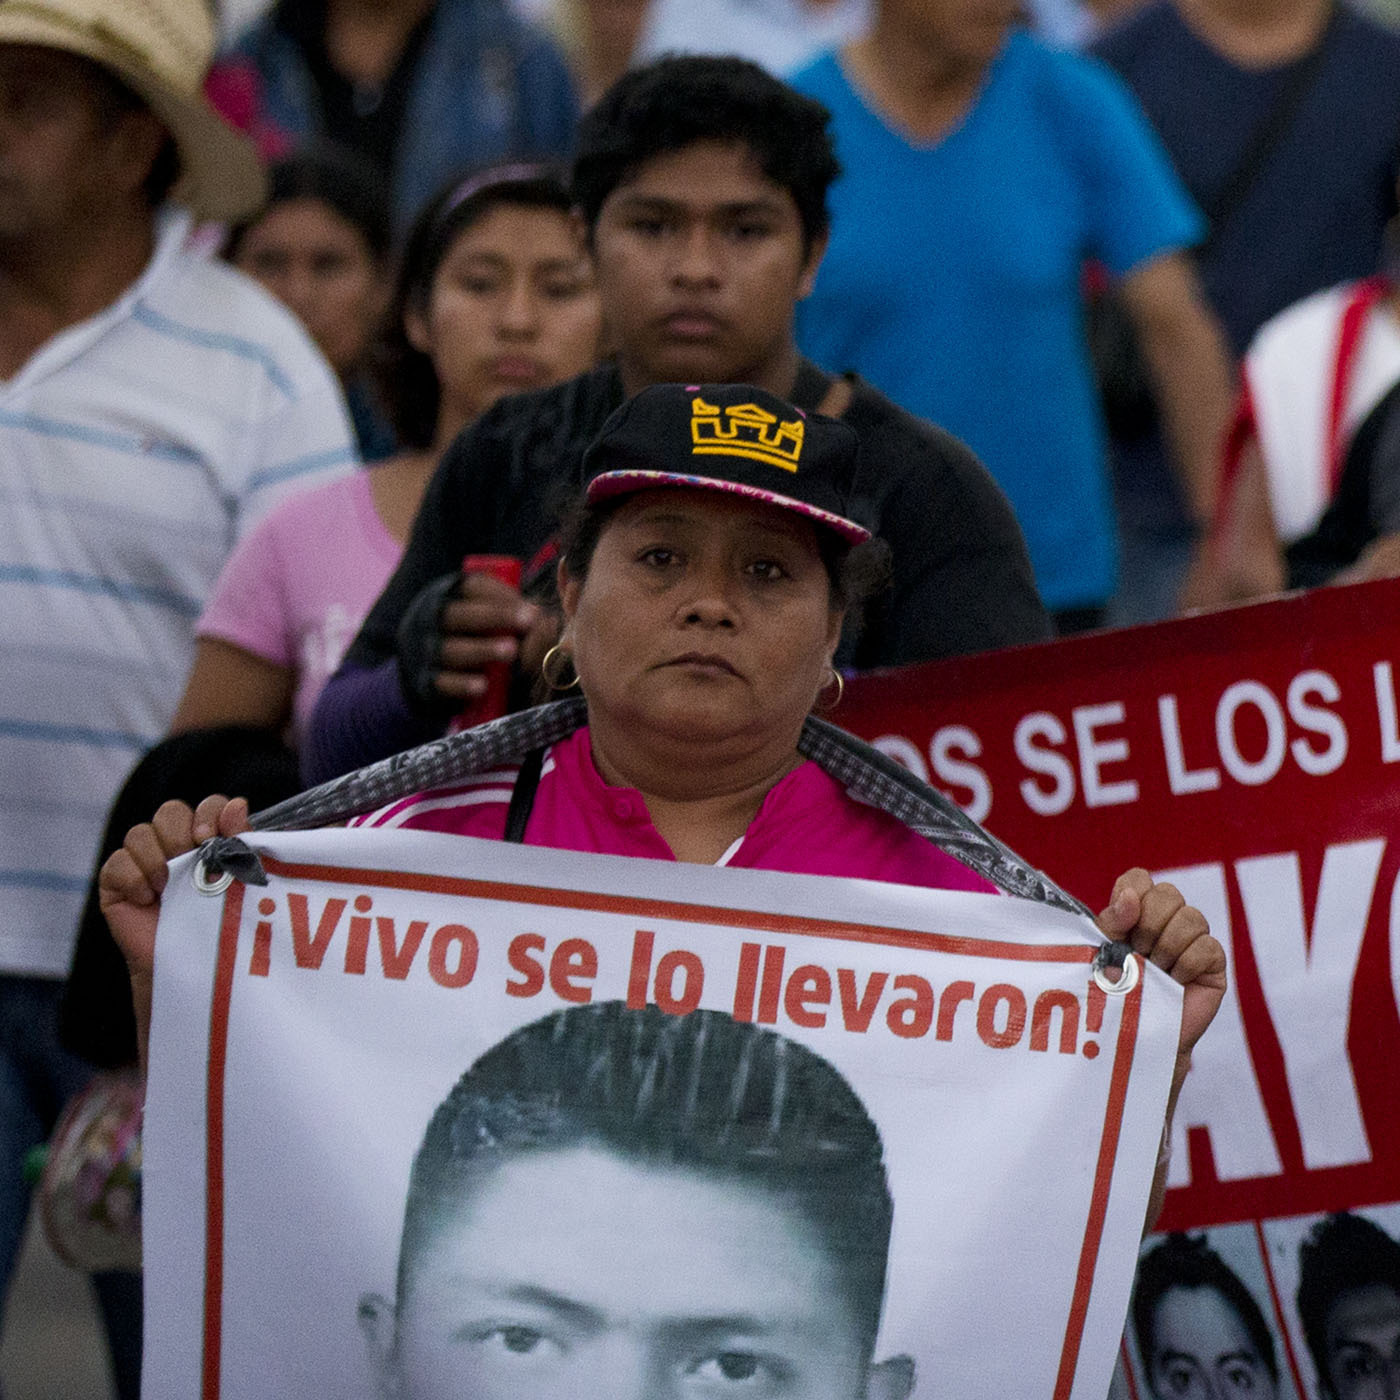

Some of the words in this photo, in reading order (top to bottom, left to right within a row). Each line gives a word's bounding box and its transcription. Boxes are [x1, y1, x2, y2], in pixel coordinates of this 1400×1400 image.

[1013, 701, 1139, 817] SE
[1158, 670, 1349, 795] LOS
[249, 892, 479, 988] ¡Vivo
[505, 932, 599, 1004] se
[626, 930, 705, 1017] lo
[732, 941, 1108, 1060] llevaron!
